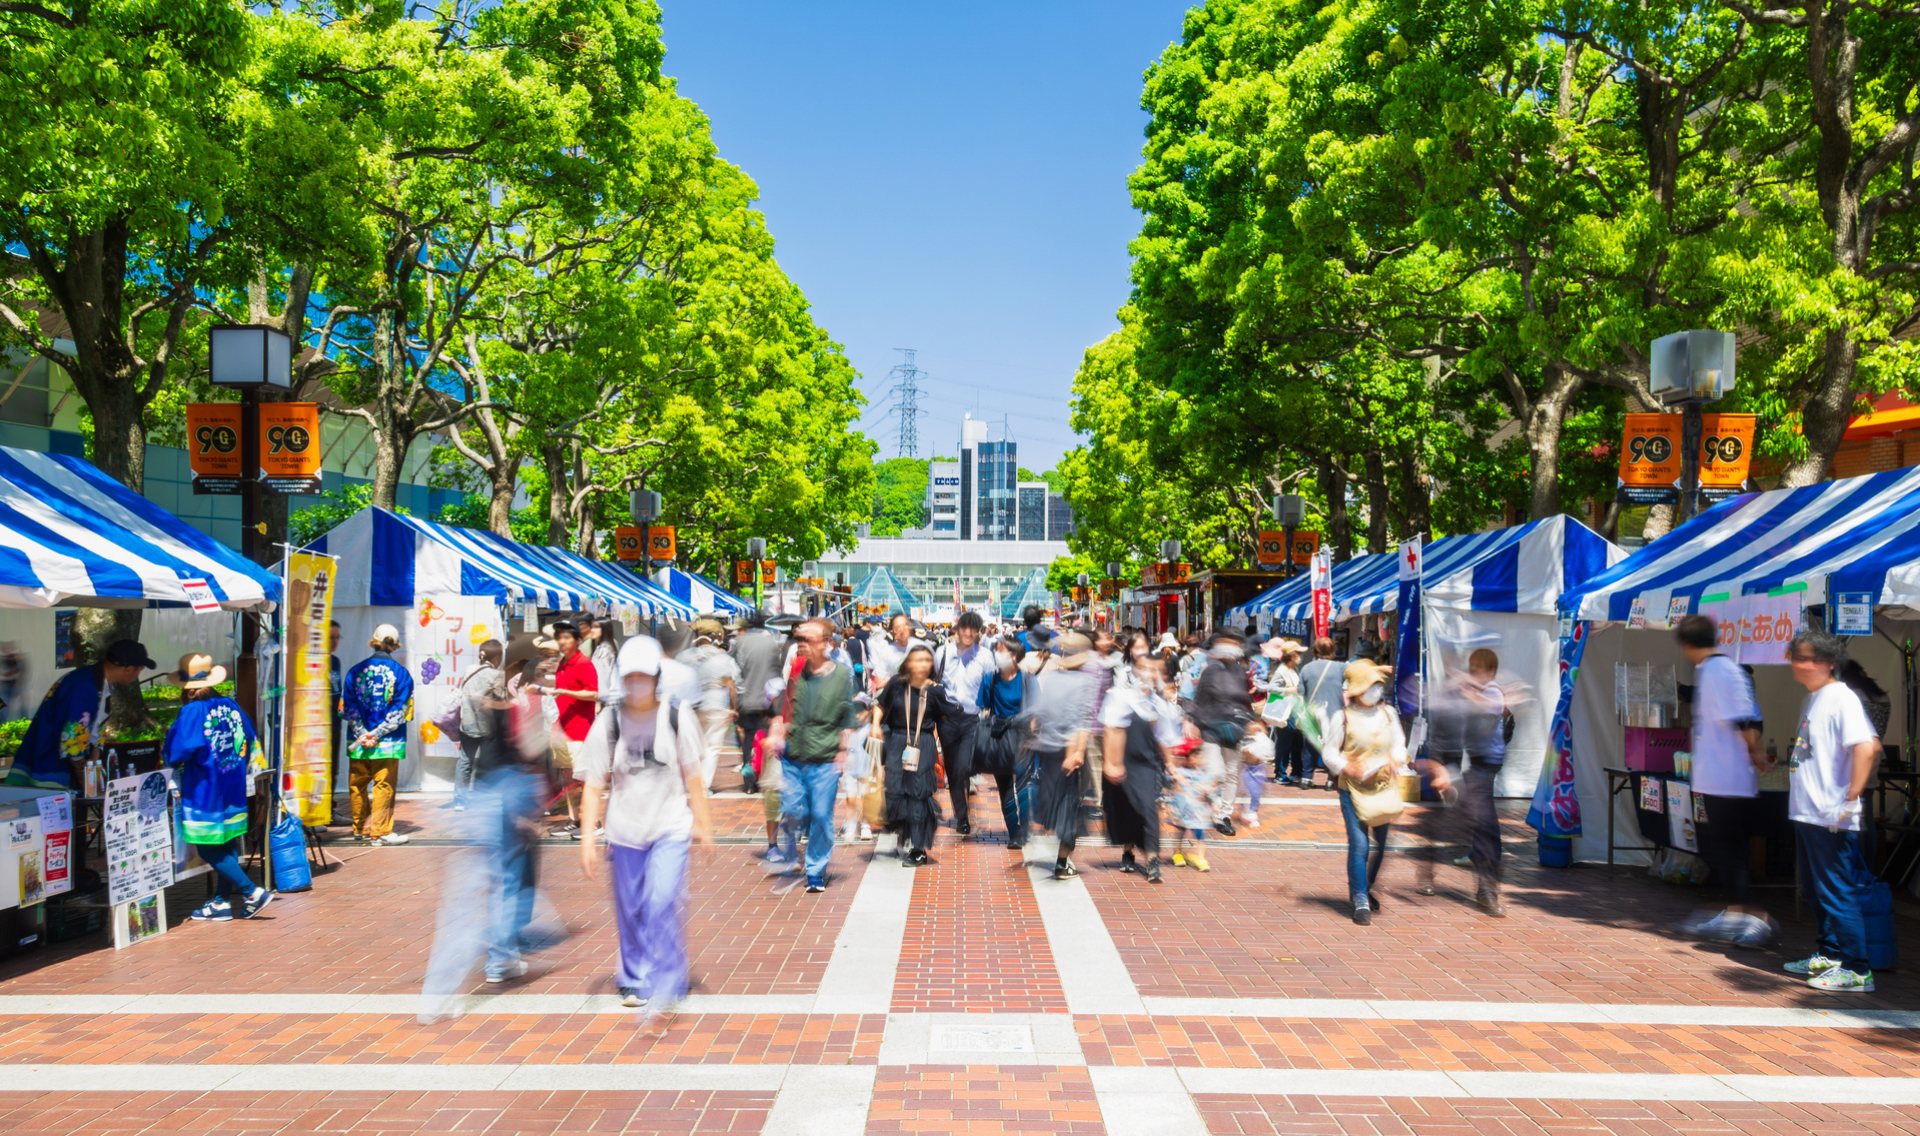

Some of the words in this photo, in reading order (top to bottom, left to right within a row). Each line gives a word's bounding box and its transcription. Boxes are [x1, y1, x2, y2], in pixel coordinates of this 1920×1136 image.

[195, 424, 238, 454] 90
[266, 424, 311, 454] 90
[1628, 434, 1673, 464] 90
[1703, 434, 1744, 464] 90
[619, 536, 639, 550] 90
[652, 536, 671, 550] 90
[1262, 540, 1281, 554] 90
[1295, 541, 1314, 554] 90
[1175, 569, 1187, 579] 90
[1717, 611, 1794, 646] わたあめ
